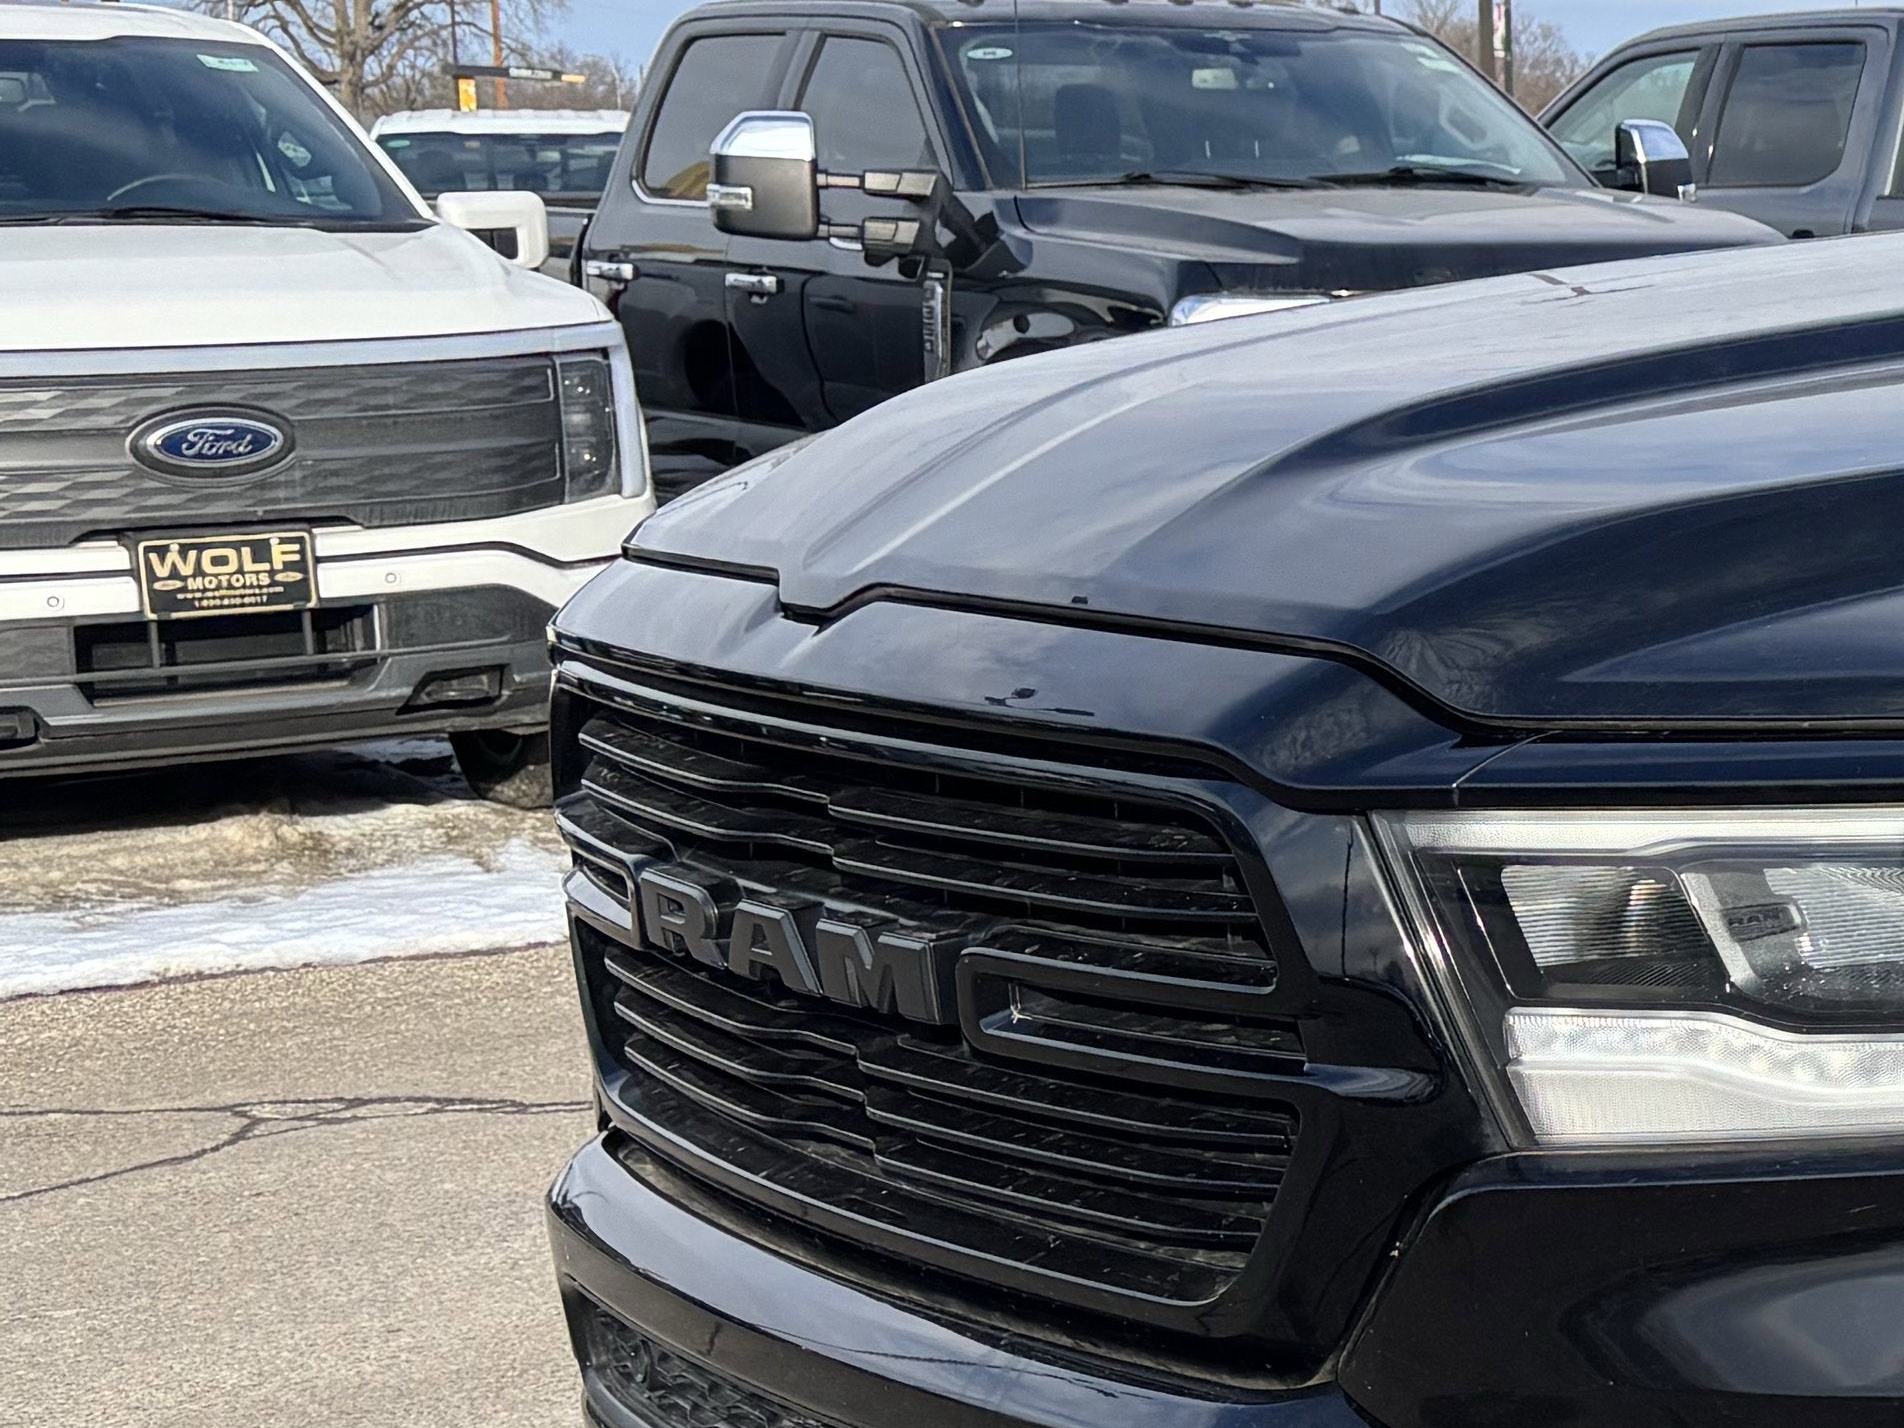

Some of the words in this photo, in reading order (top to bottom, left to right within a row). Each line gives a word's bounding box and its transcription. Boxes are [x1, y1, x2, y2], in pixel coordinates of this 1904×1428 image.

[182, 429, 253, 456] Ford
[149, 544, 300, 577] WOLF
[187, 573, 271, 590] MOTORS
[639, 868, 942, 1025] RAM
